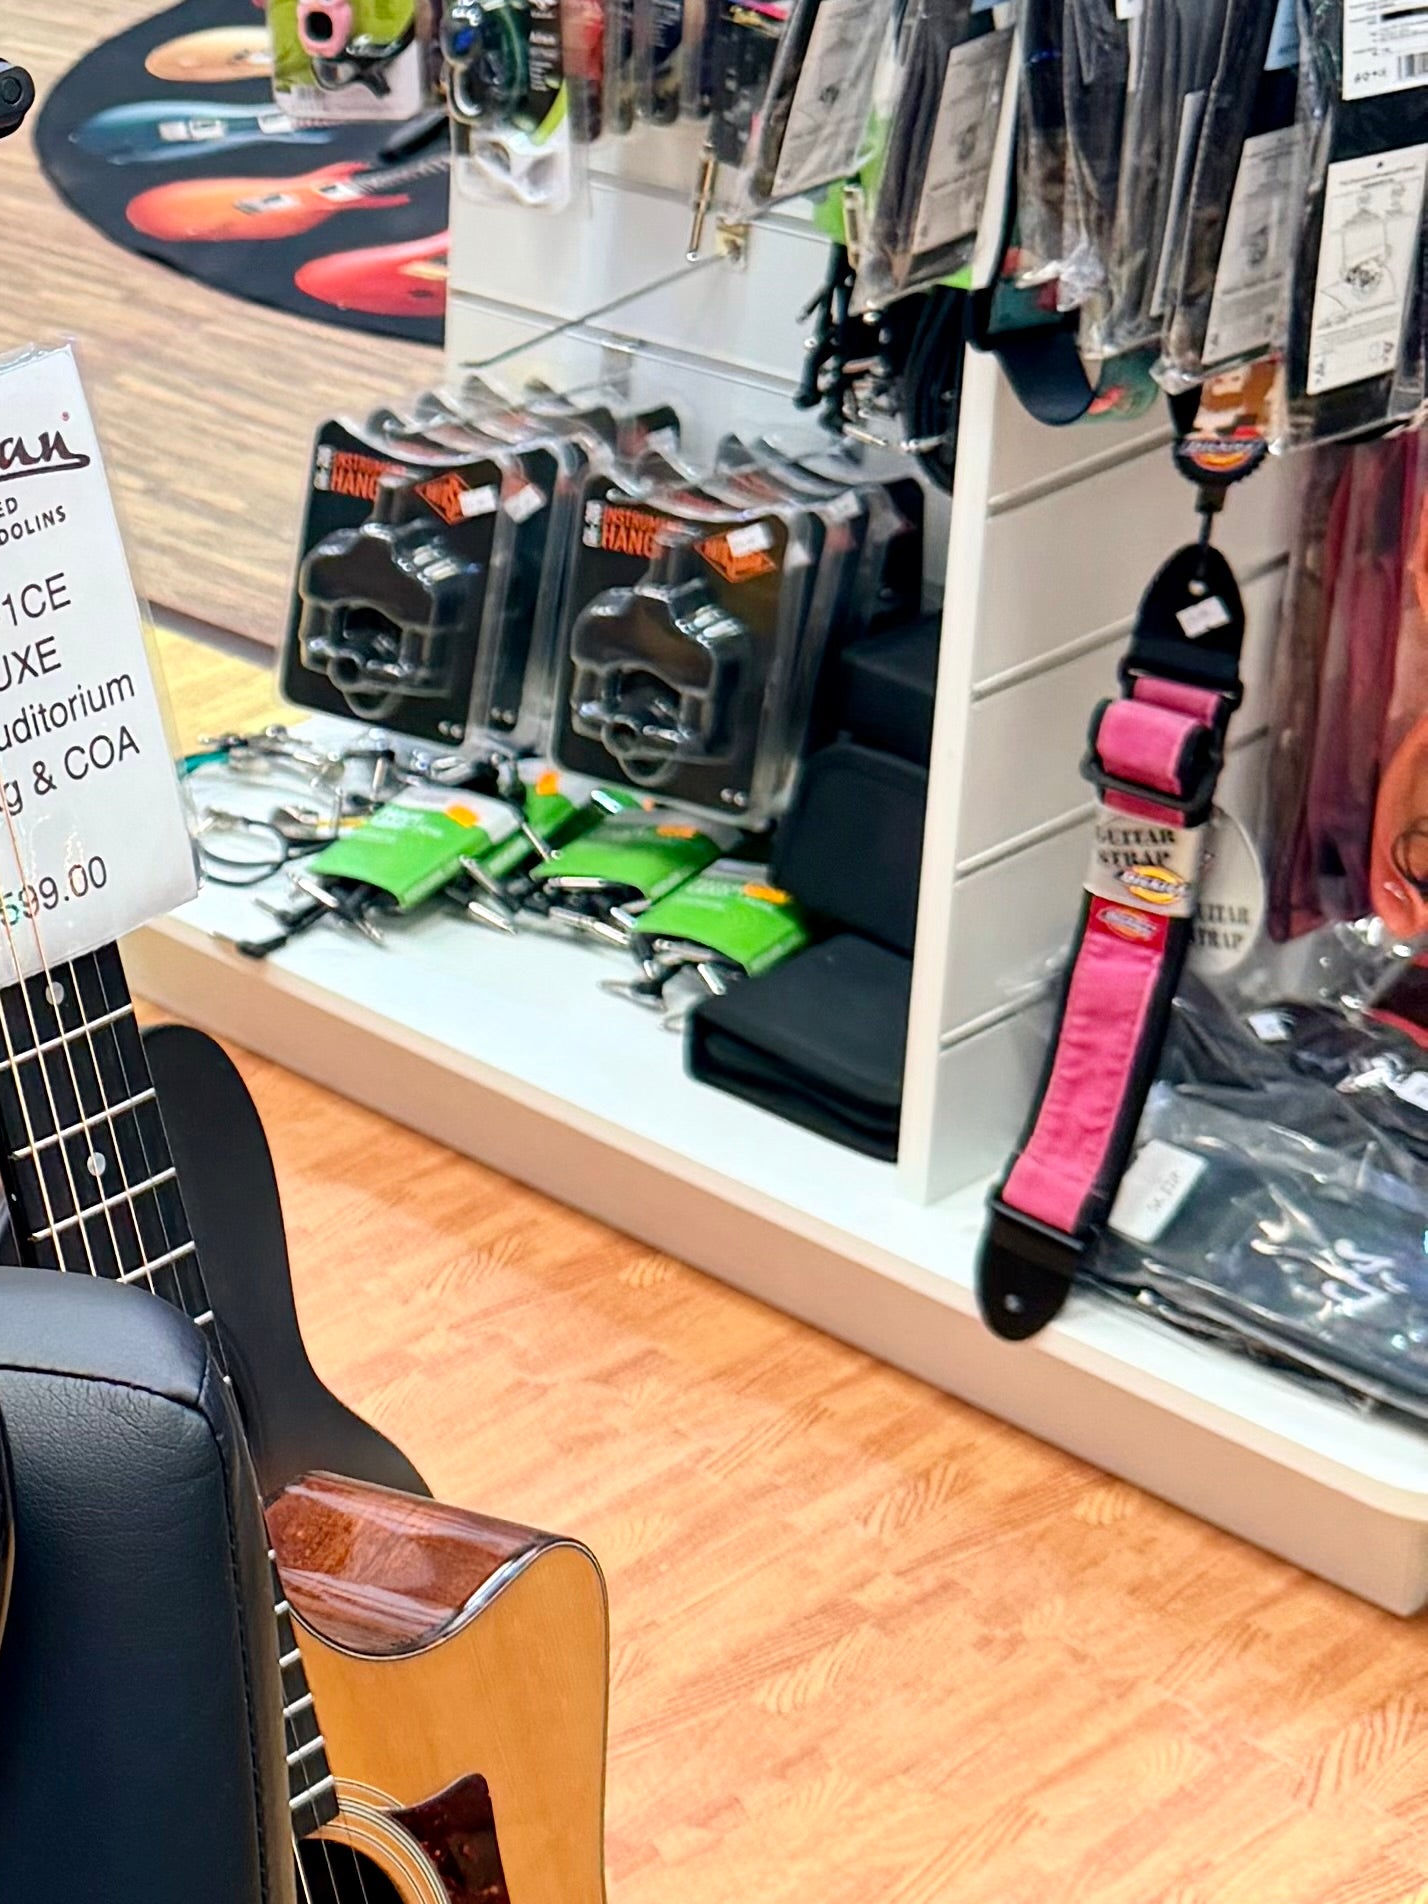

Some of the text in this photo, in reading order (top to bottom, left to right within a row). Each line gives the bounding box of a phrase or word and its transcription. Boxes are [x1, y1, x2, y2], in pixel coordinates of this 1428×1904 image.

[32, 760, 58, 796] &
[63, 725, 141, 781] COA
[1196, 928, 1244, 949] TRAP
